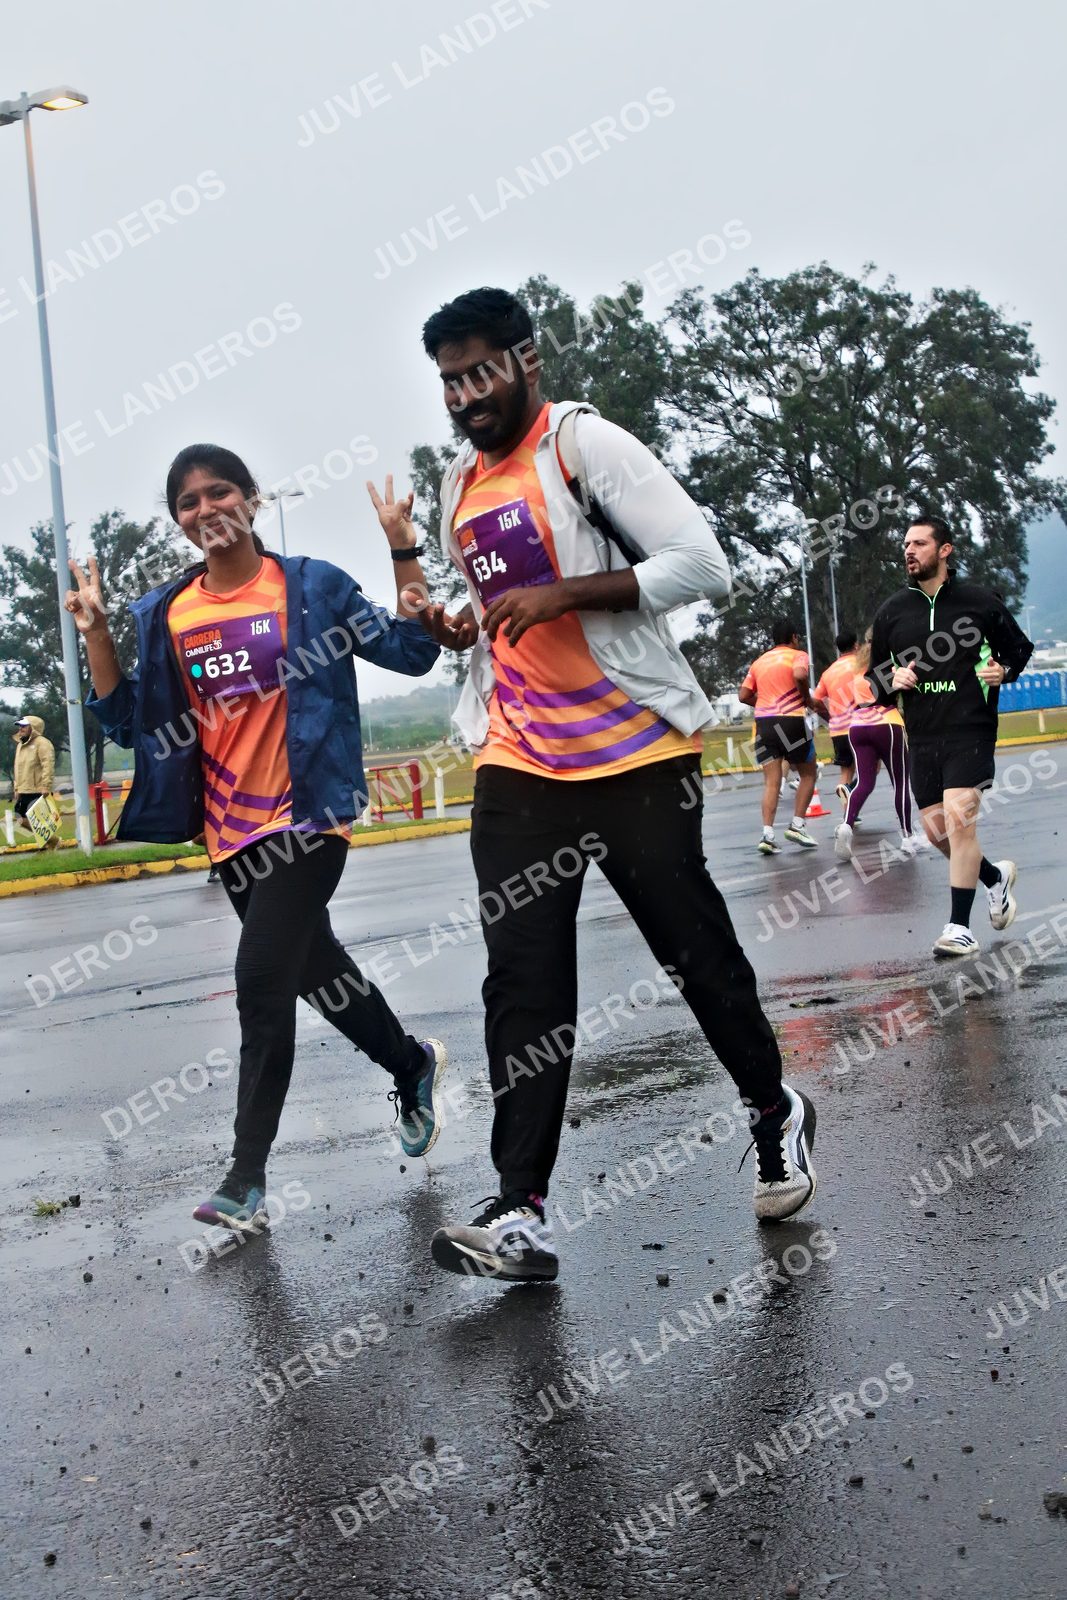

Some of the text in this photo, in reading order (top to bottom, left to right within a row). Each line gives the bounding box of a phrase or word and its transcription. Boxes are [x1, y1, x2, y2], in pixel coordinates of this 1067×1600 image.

[497, 508, 522, 532] 15K
[472, 550, 507, 583] 634
[250, 618, 271, 636] 15K
[184, 628, 222, 649] CARRERA
[185, 643, 214, 658] OMNILIFE
[204, 649, 252, 679] 632
[924, 680, 957, 694] PUMA
